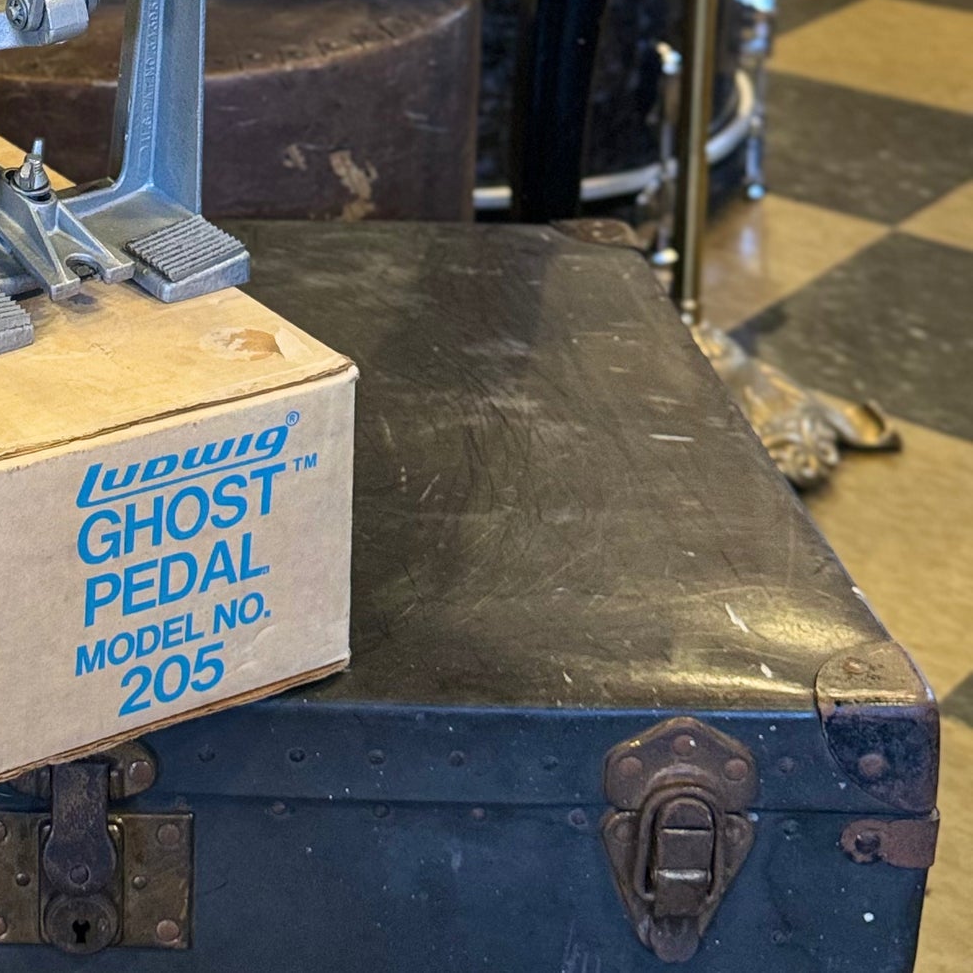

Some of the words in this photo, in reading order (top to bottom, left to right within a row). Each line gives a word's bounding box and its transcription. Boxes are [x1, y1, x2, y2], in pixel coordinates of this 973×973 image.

[78, 463, 286, 565] GHOST
[84, 532, 270, 628] PEDAL
[75, 612, 205, 677] MODEL
[213, 592, 271, 634] NO.
[118, 641, 225, 717] 205
